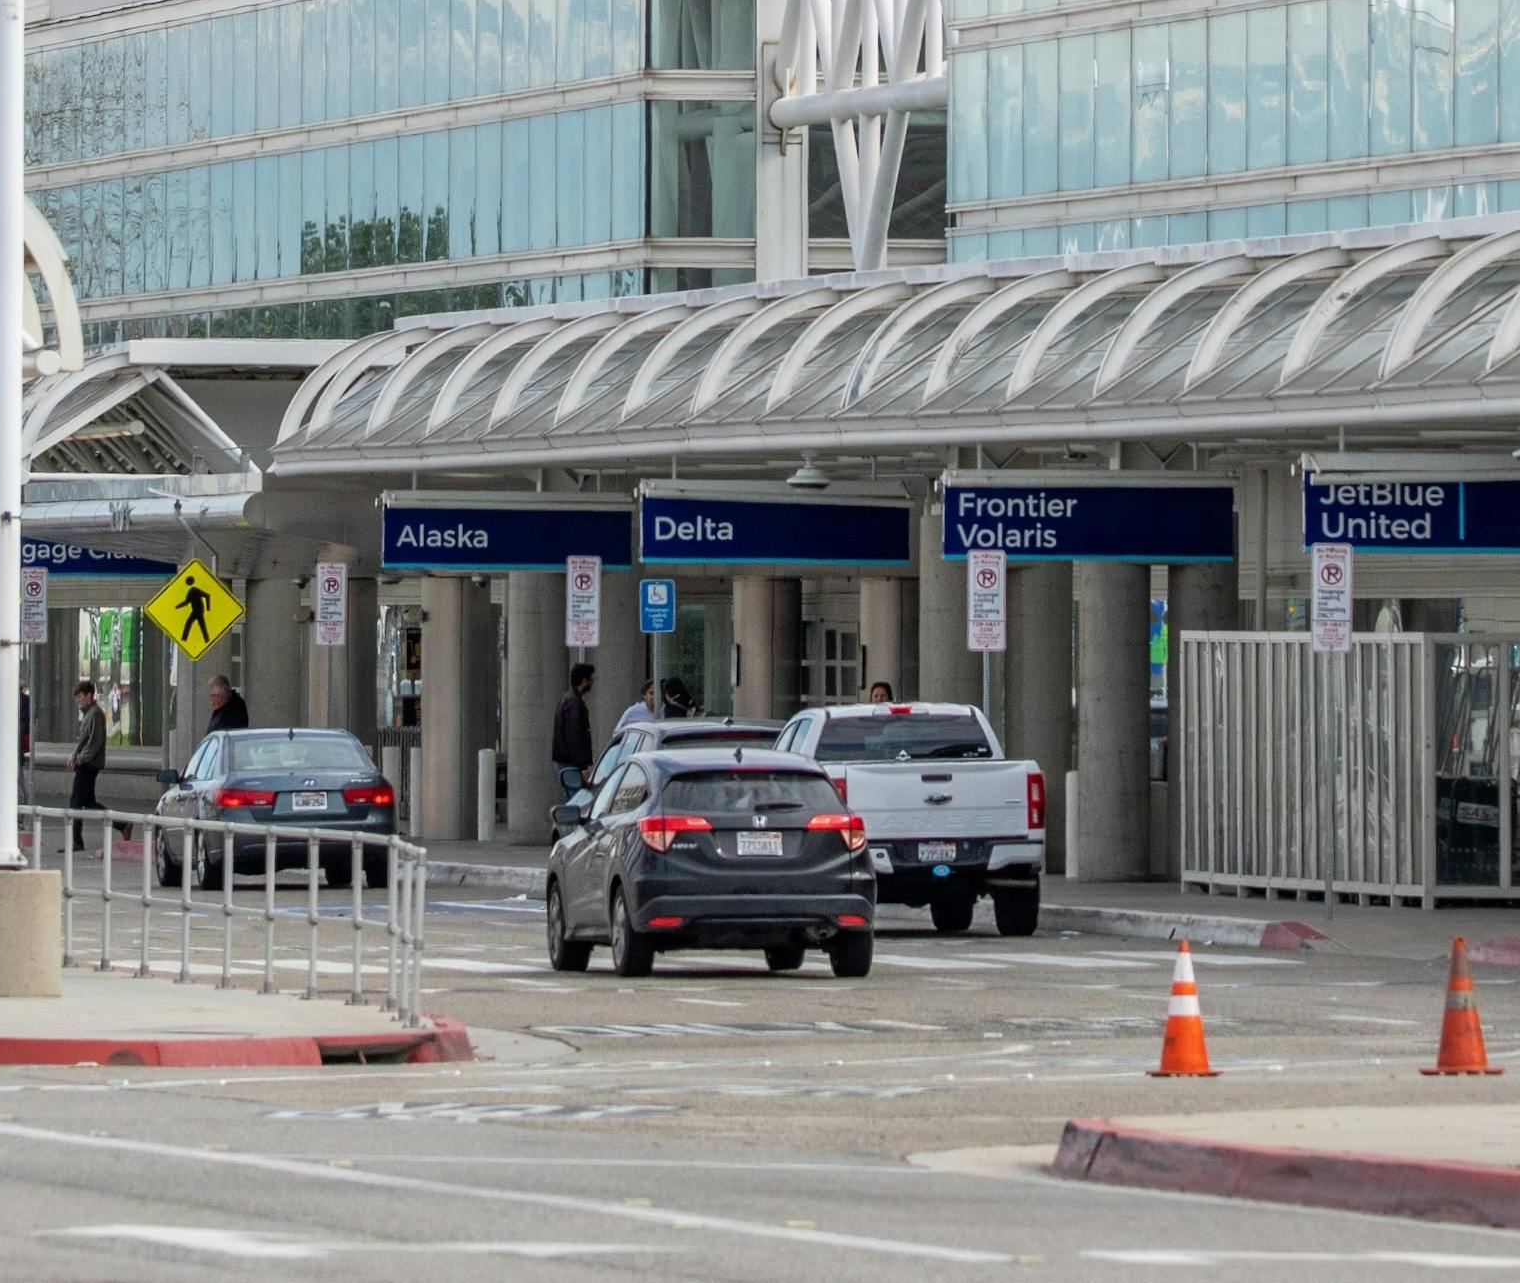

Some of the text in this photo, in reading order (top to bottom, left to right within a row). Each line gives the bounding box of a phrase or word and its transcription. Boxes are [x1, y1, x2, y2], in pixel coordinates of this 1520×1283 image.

[959, 492, 1078, 517] Frontier
[1320, 483, 1445, 507] JetBlue
[396, 523, 488, 548] Alaska
[654, 515, 733, 541] Delta
[958, 523, 1057, 548] Volaris
[1322, 511, 1431, 539] United
